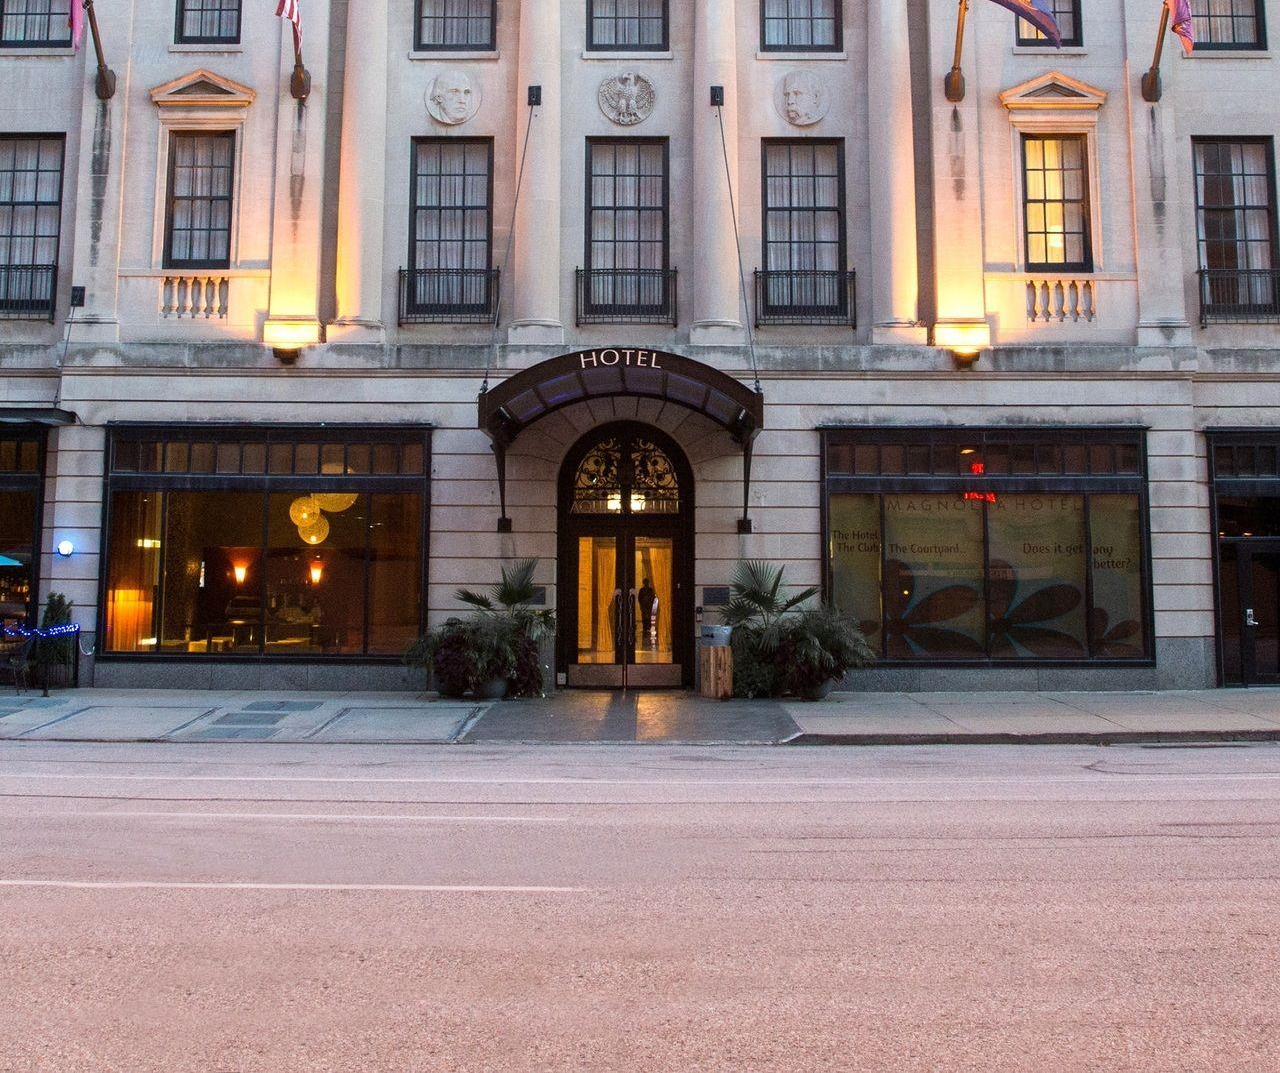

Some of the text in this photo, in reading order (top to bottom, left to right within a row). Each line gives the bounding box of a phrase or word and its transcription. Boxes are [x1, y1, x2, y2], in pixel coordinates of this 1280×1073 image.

[580, 349, 662, 369] HOTEL
[887, 499, 1081, 512] MAGNOLA HOTEL
[833, 530, 878, 540] The Hotel
[837, 543, 854, 552] The
[888, 543, 907, 554] The
[1023, 543, 1113, 557] Does it get any
[1093, 558, 1131, 570] better?
